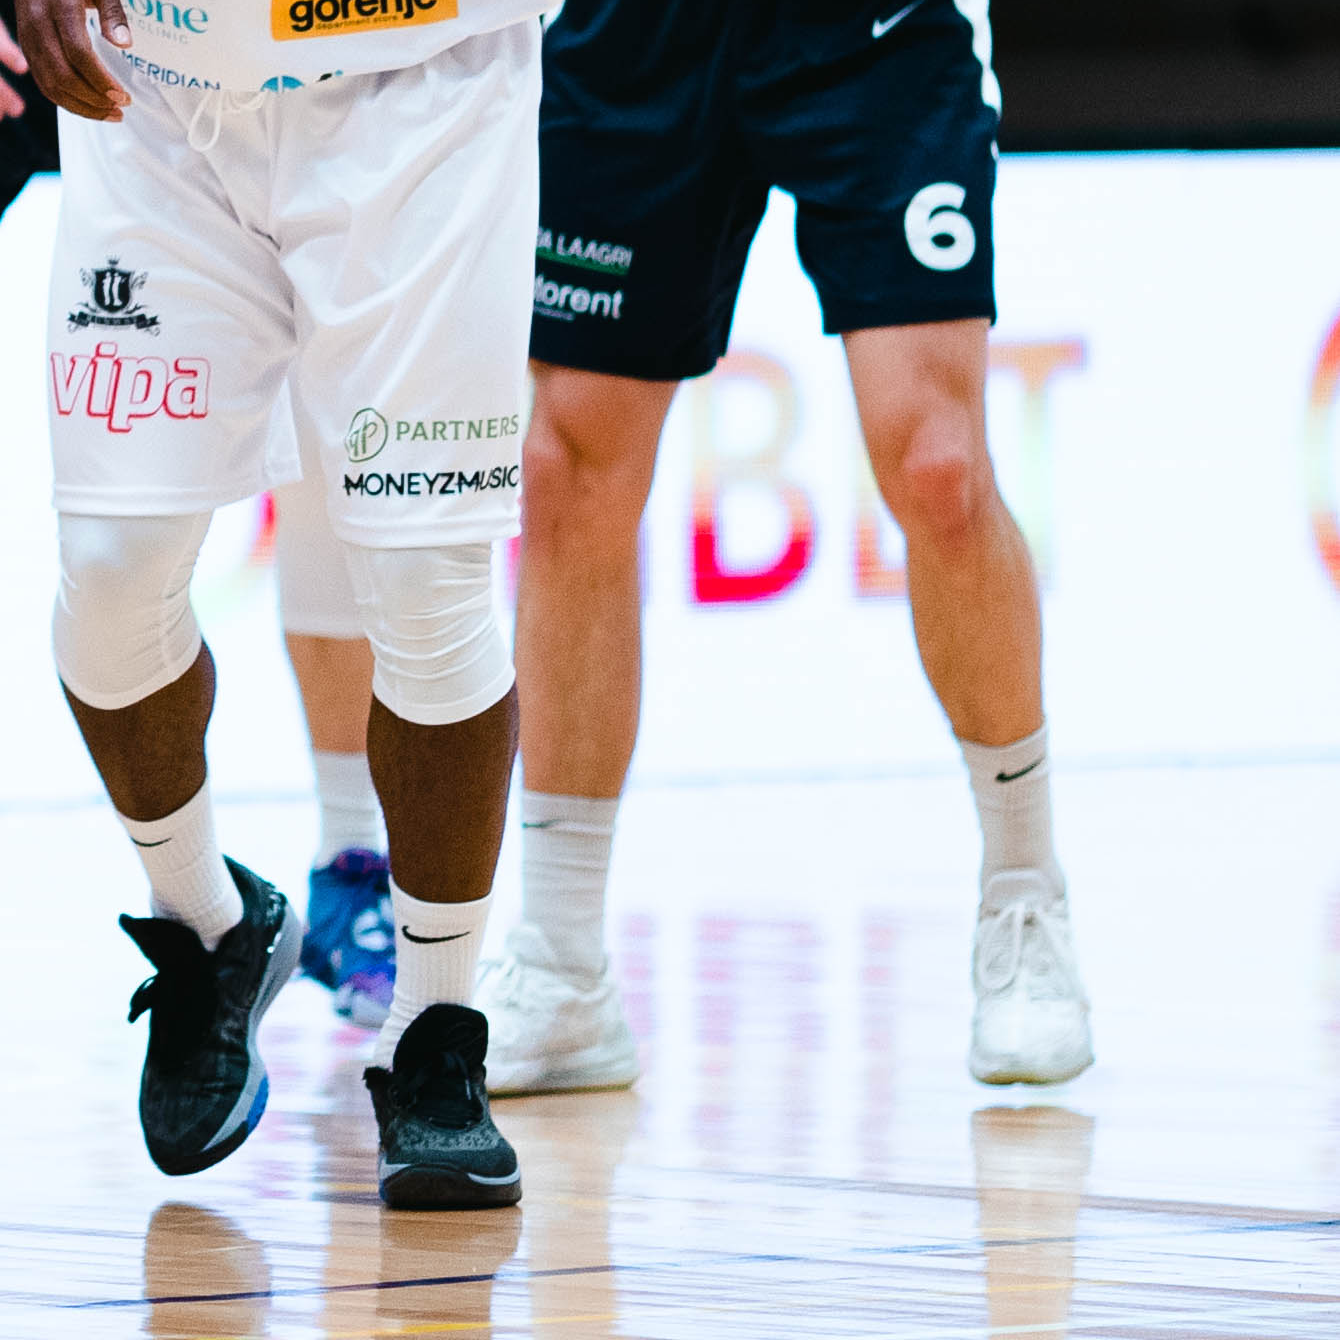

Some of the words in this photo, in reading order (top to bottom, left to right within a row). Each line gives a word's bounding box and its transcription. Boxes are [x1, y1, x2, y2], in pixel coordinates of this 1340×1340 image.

[903, 181, 977, 271] 6
[50, 341, 211, 434] vipa
[395, 414, 519, 442] PARTNERS
